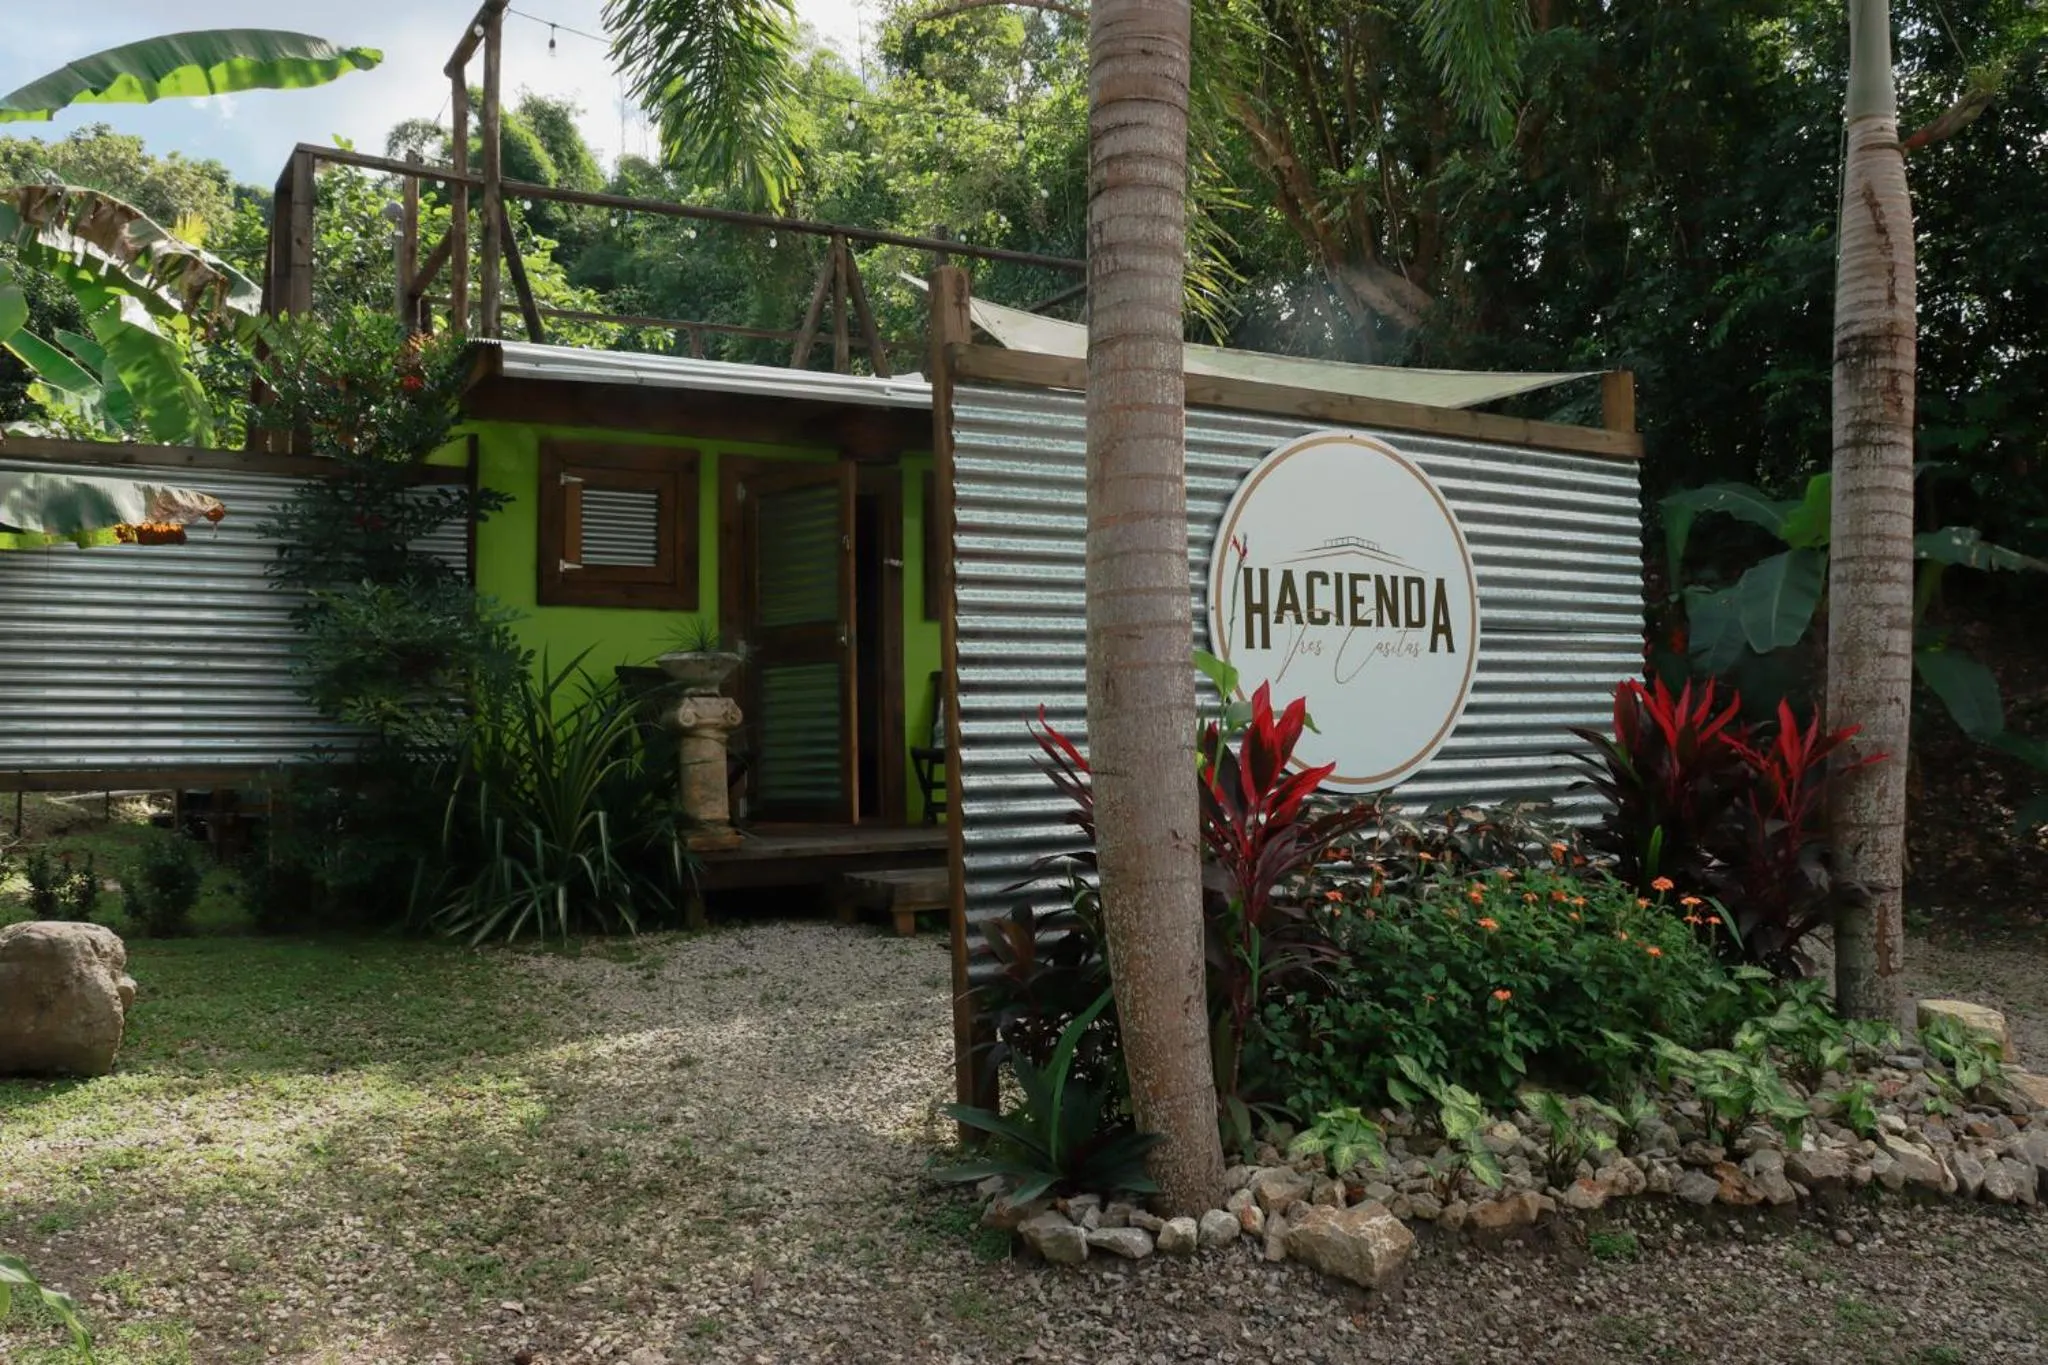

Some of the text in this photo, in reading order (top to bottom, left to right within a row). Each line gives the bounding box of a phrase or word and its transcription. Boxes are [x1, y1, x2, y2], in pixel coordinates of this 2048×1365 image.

[1243, 567, 1455, 653] HACIENDA
[1273, 608, 1422, 684] Tres Casitas
